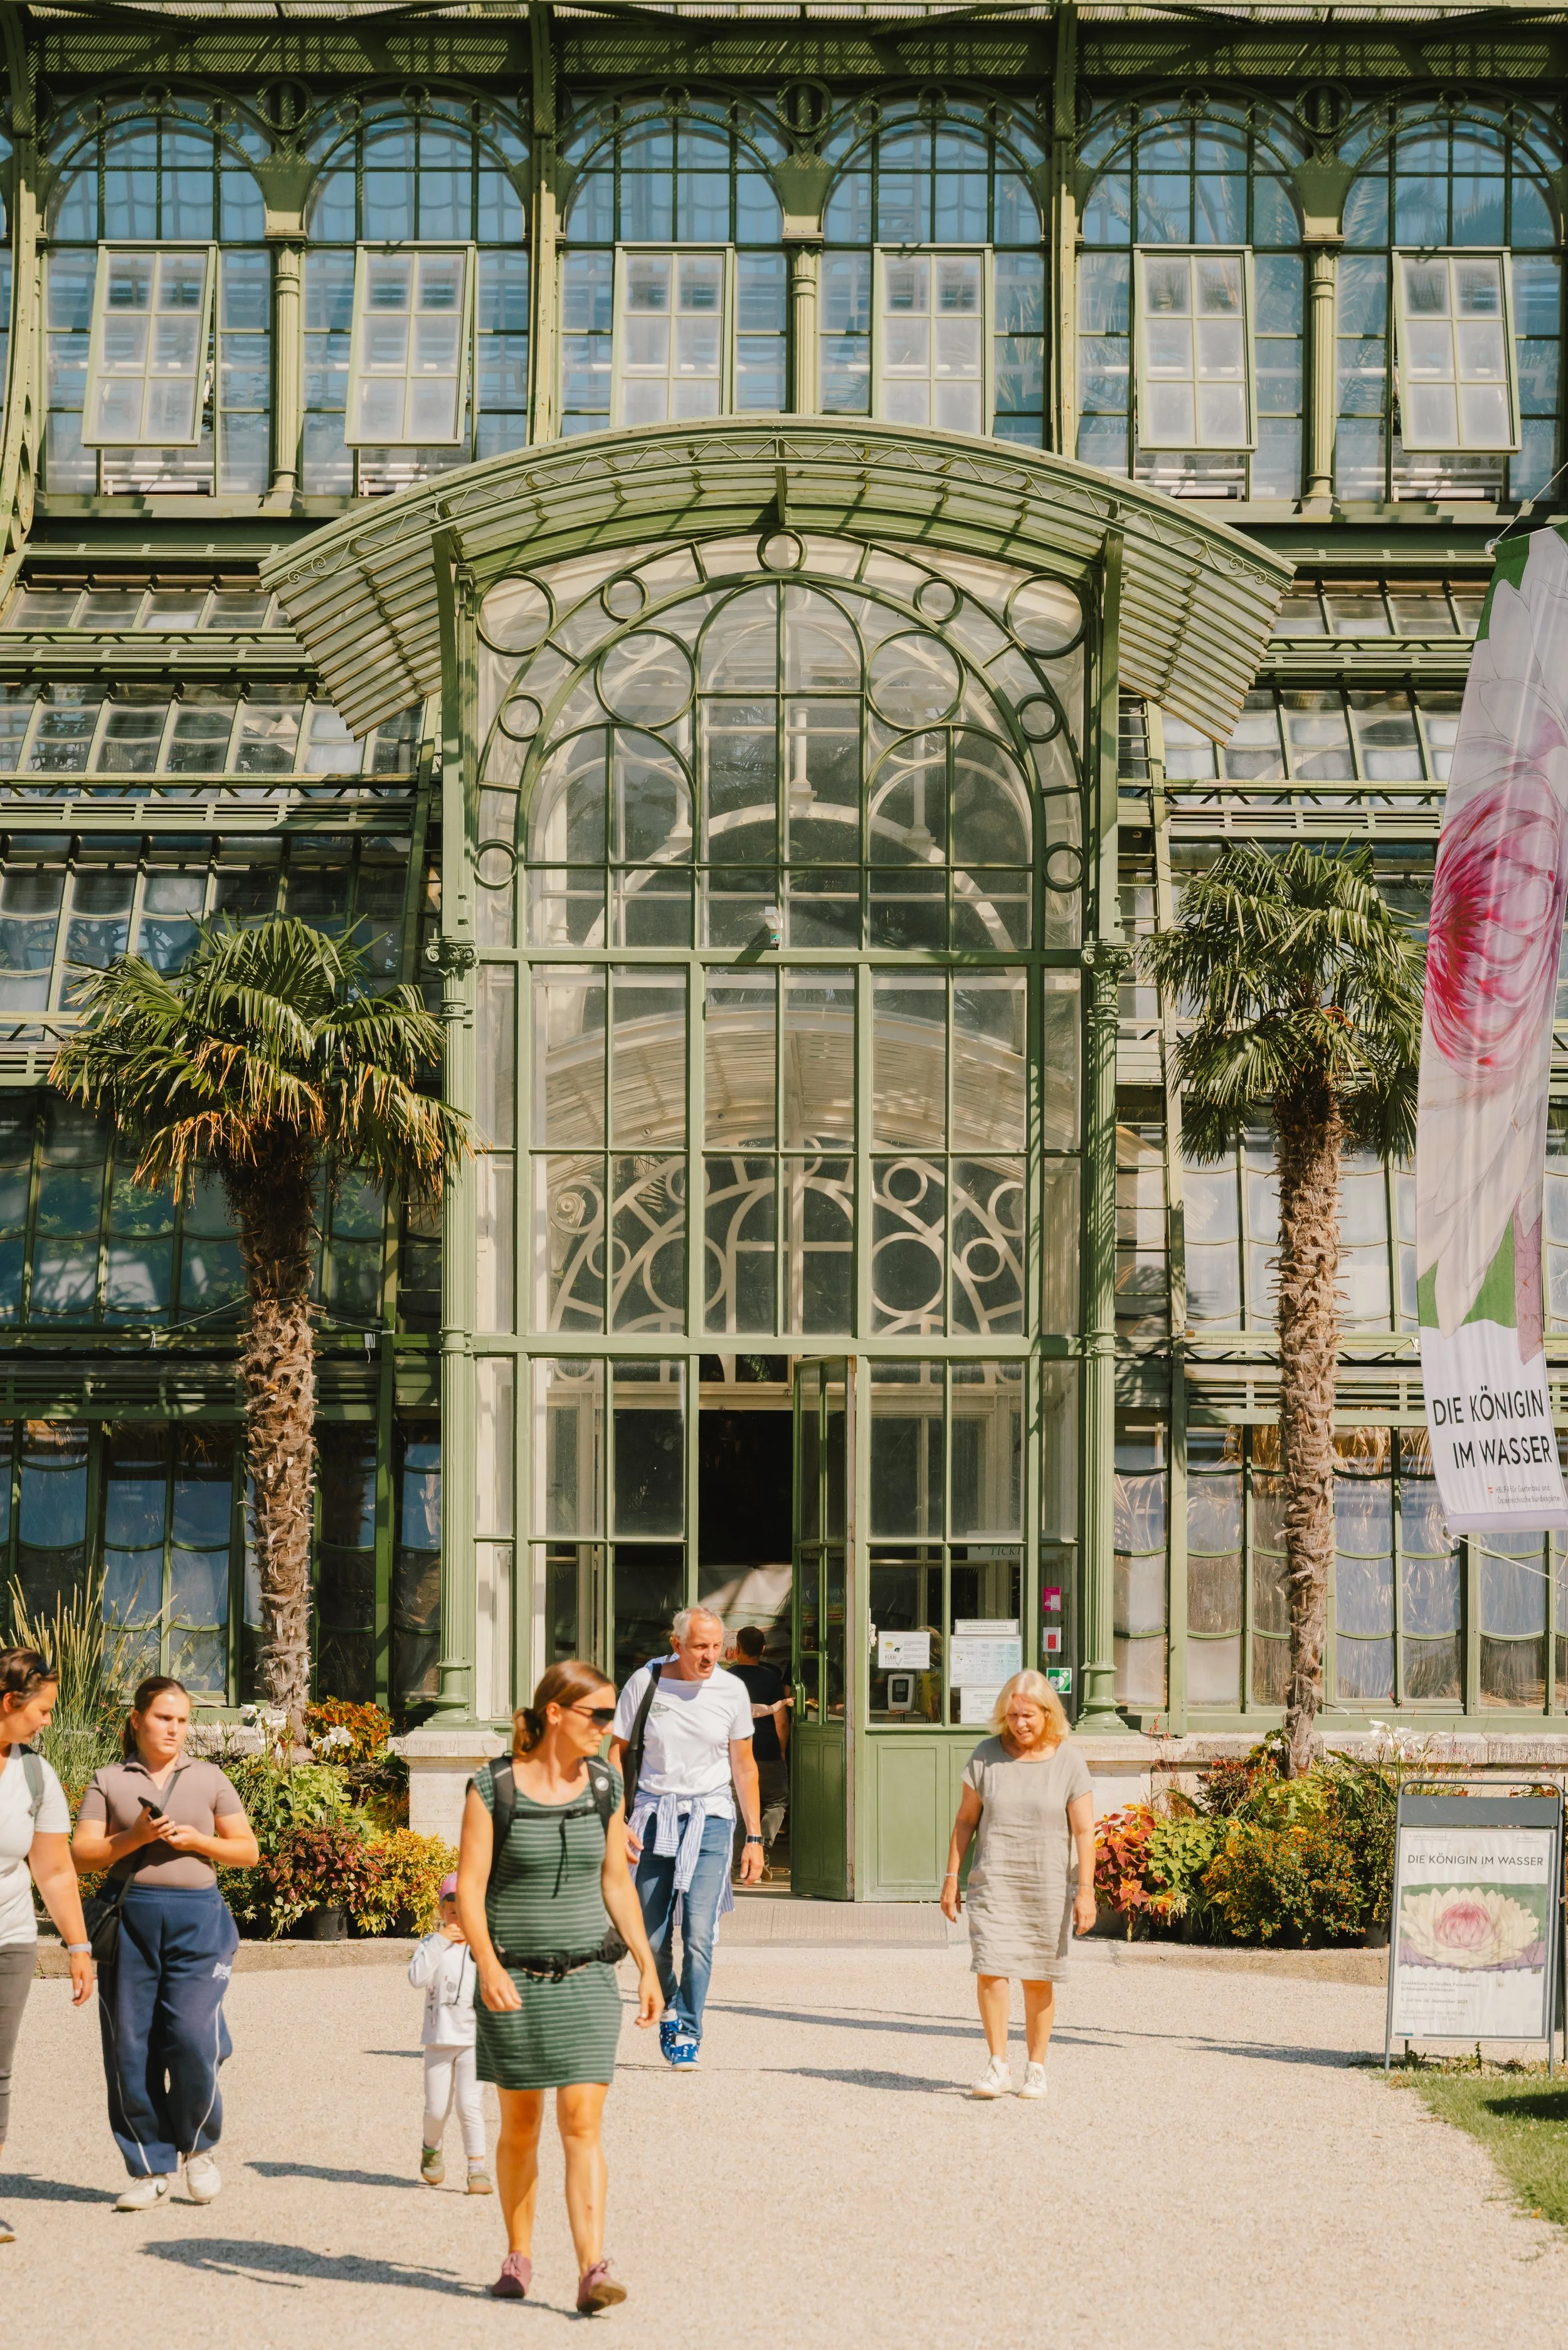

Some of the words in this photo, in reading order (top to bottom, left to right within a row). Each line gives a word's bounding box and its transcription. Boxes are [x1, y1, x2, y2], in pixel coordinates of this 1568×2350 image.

[1433, 1397, 1464, 1426] DIE
[1470, 1385, 1544, 1422] KÖNIGIN
[1453, 1441, 1475, 1469] IM
[1479, 1435, 1552, 1466] WASSER
[1518, 1484, 1540, 1492] Gartenbau
[1408, 1854, 1425, 1863] DIE
[1429, 1853, 1477, 1864] KÖNIGIN
[1481, 1856, 1493, 1865] IM
[1498, 1856, 1544, 1866] WASSER
